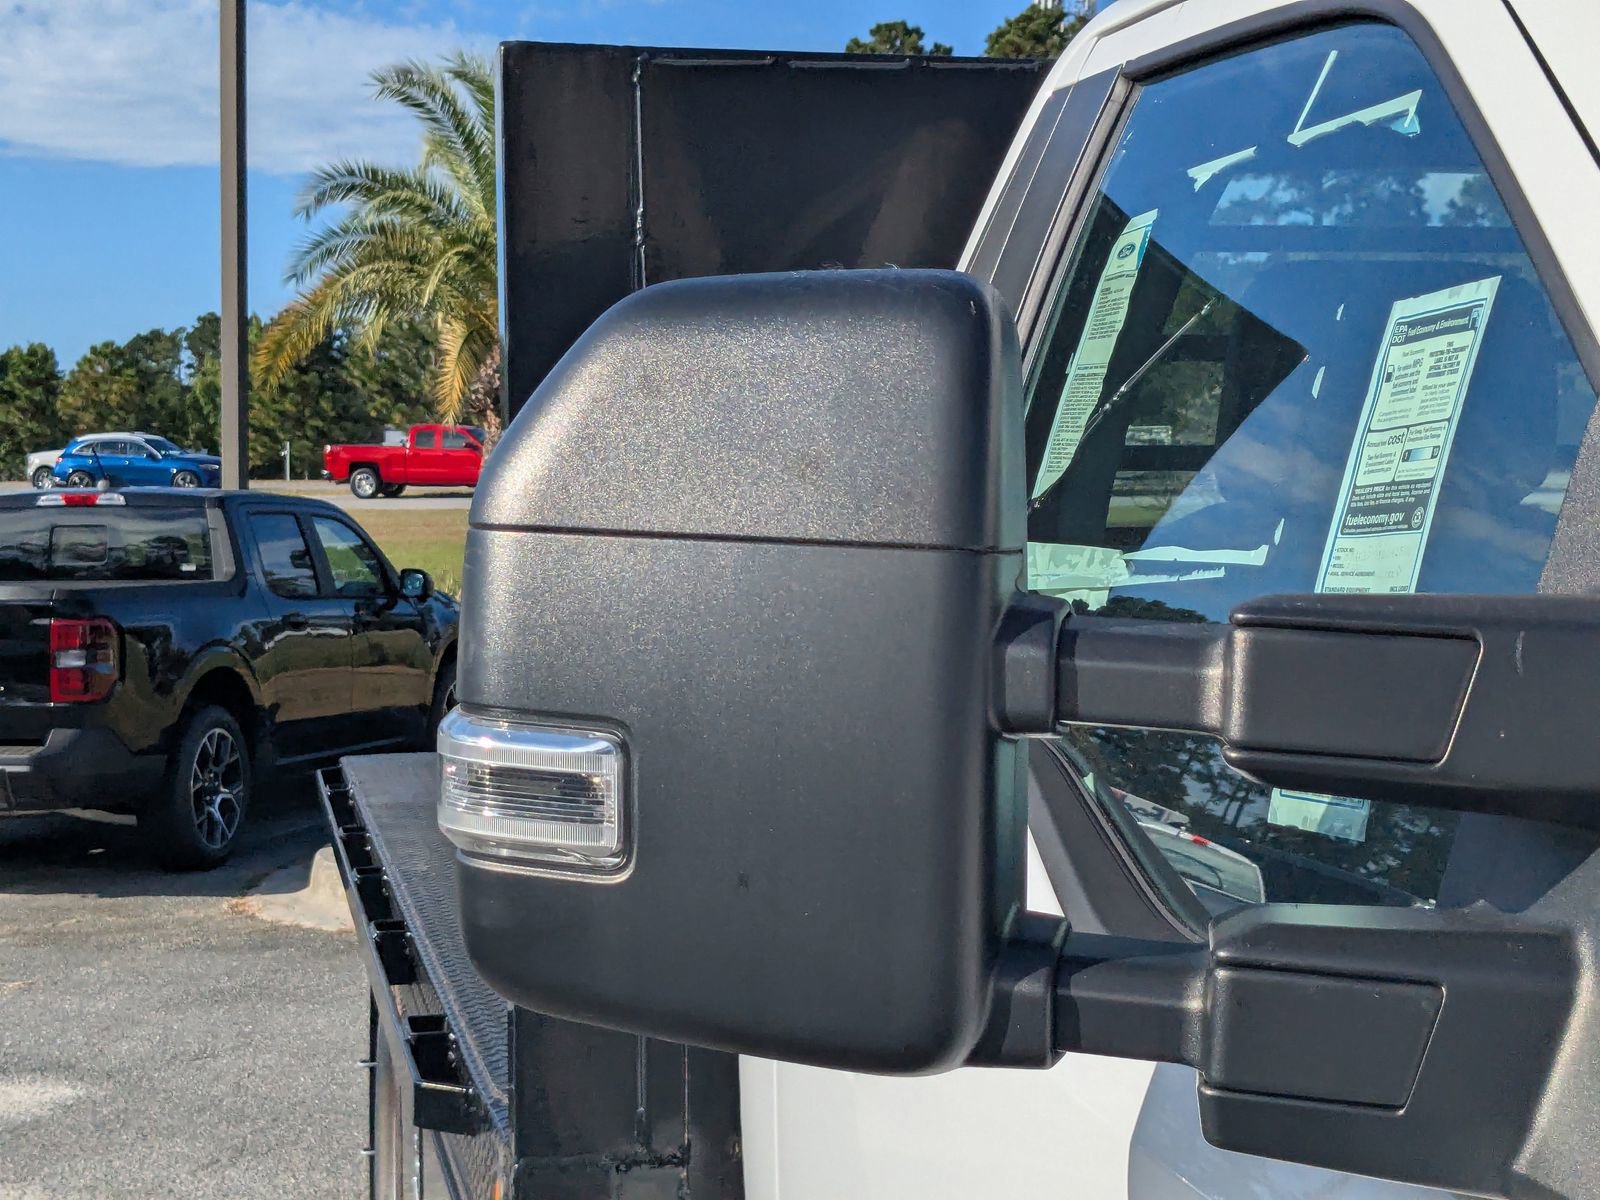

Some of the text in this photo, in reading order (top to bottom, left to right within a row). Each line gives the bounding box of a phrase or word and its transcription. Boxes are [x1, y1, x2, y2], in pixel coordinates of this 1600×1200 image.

[1394, 325, 1408, 334] EPA
[1407, 316, 1469, 337] Fuel Economy & Environment
[1391, 335, 1405, 344] DOT
[1387, 431, 1405, 446] cost
[1345, 512, 1406, 526] fueleconomy.gov
